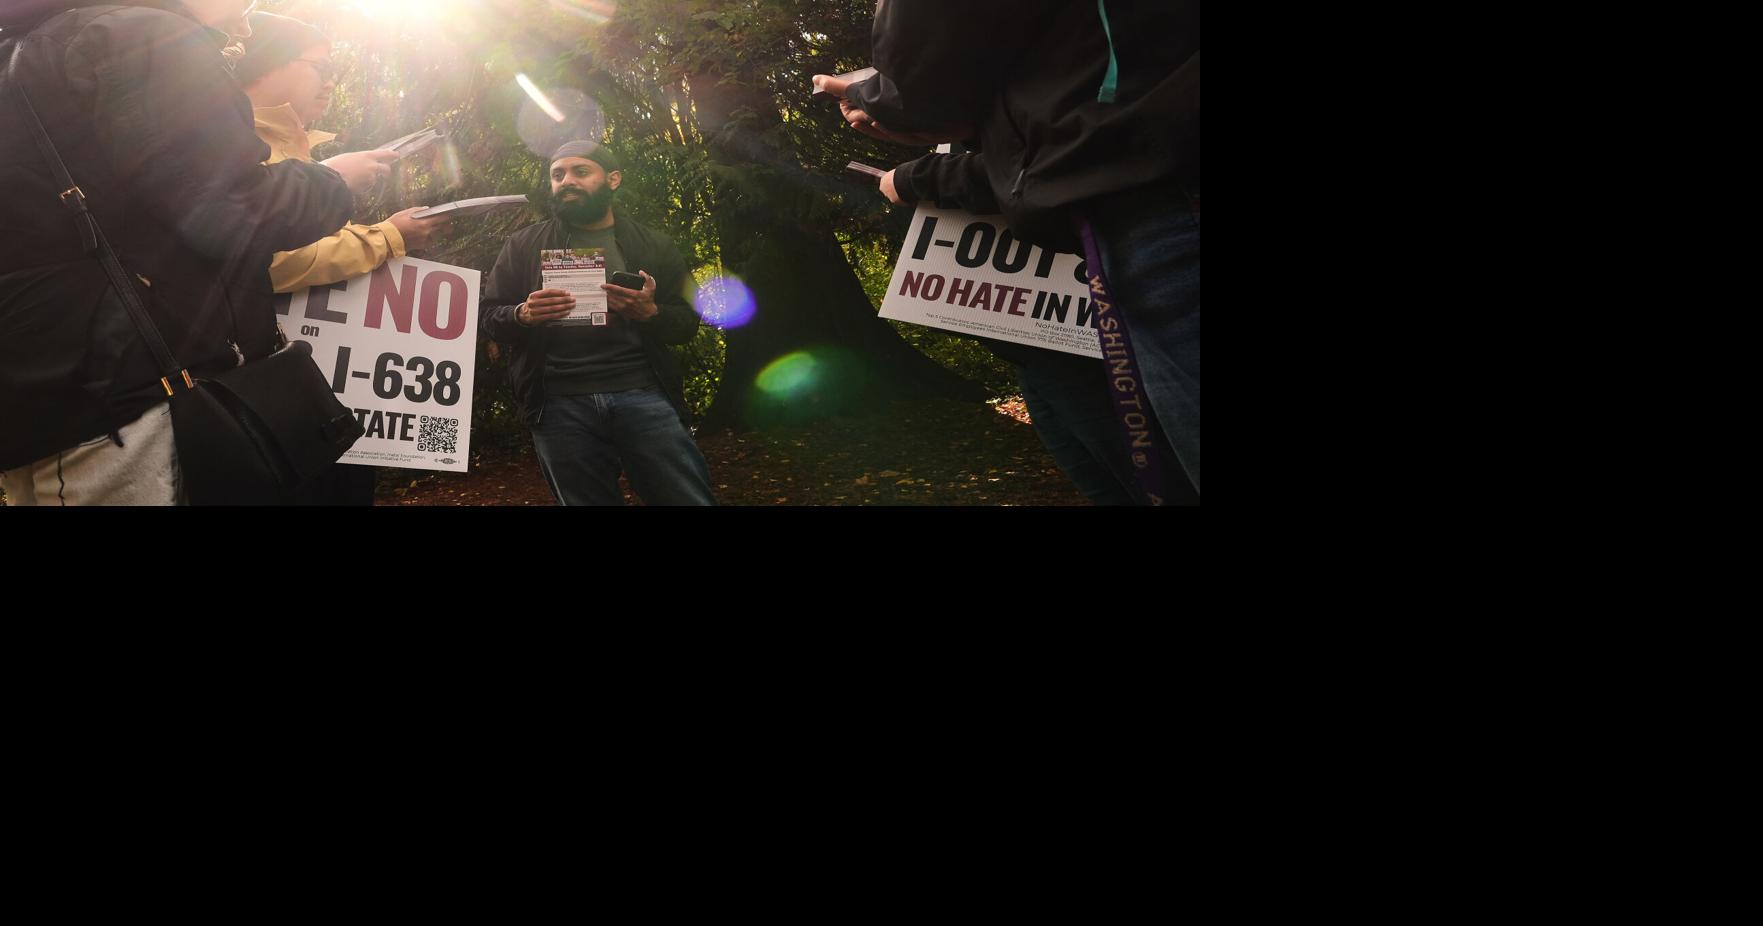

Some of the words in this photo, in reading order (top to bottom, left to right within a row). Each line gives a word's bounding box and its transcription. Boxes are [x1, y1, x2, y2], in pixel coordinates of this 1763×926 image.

[363, 262, 468, 340] NO
[899, 270, 946, 302] NO
[946, 278, 1032, 316] HATE
[1031, 290, 1073, 324] IN
[301, 325, 320, 337] on
[332, 345, 462, 406] I-638
